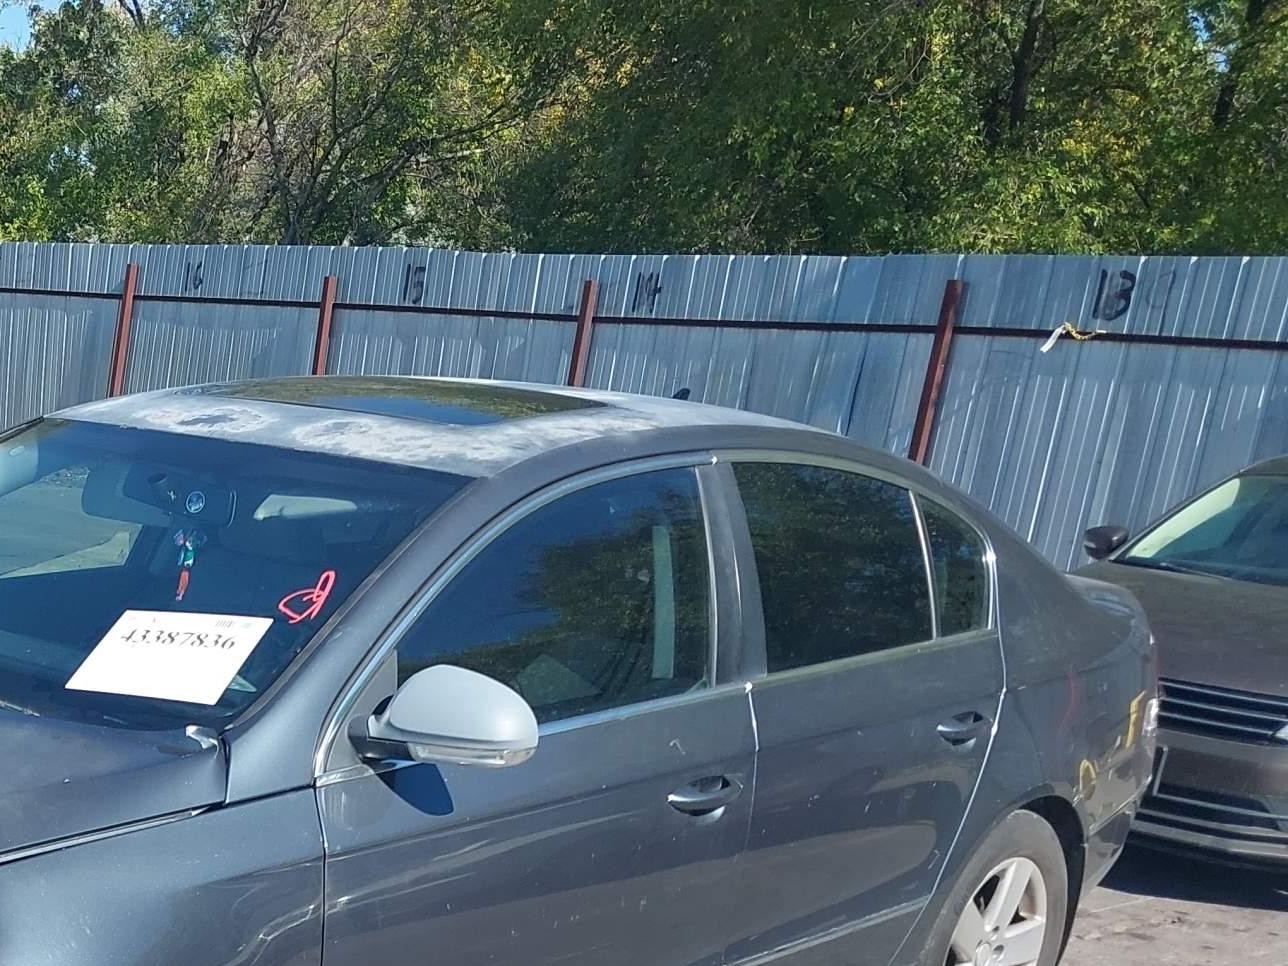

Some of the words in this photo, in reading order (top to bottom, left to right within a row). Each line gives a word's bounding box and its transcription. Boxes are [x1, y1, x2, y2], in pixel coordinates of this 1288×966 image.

[184, 260, 204, 293] 16
[402, 263, 428, 305] 15
[631, 271, 663, 314] 14
[1091, 268, 1137, 322] 13
[120, 628, 237, 651] 43387836
